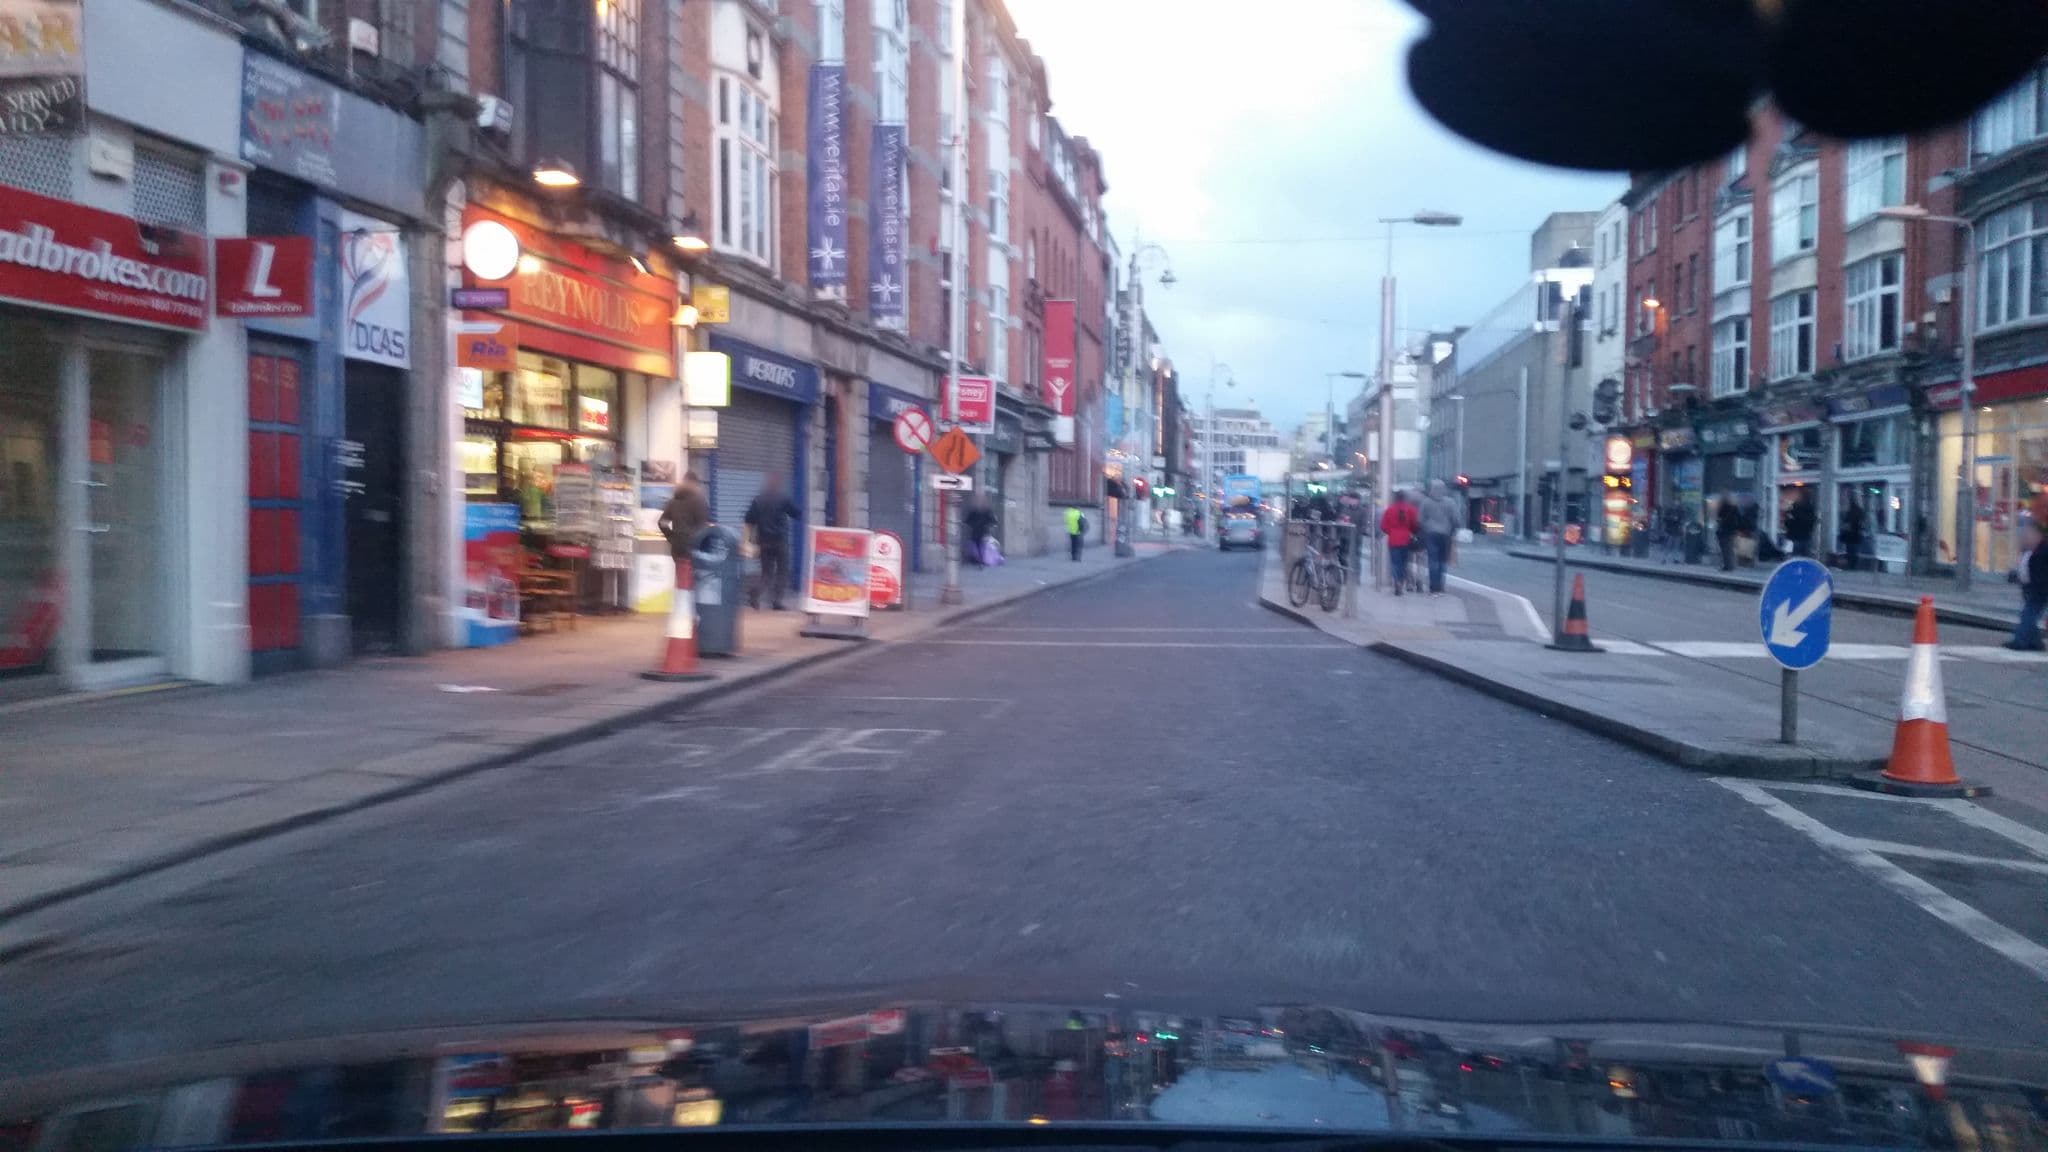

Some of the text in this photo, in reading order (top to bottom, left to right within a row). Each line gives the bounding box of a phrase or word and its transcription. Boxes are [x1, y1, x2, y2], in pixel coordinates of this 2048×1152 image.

[6, 78, 76, 113] SERVED
[823, 73, 847, 227] www.veritas.ie
[883, 132, 903, 265] www.veritas.ie
[246, 241, 282, 297] L
[354, 320, 406, 361] DCAS
